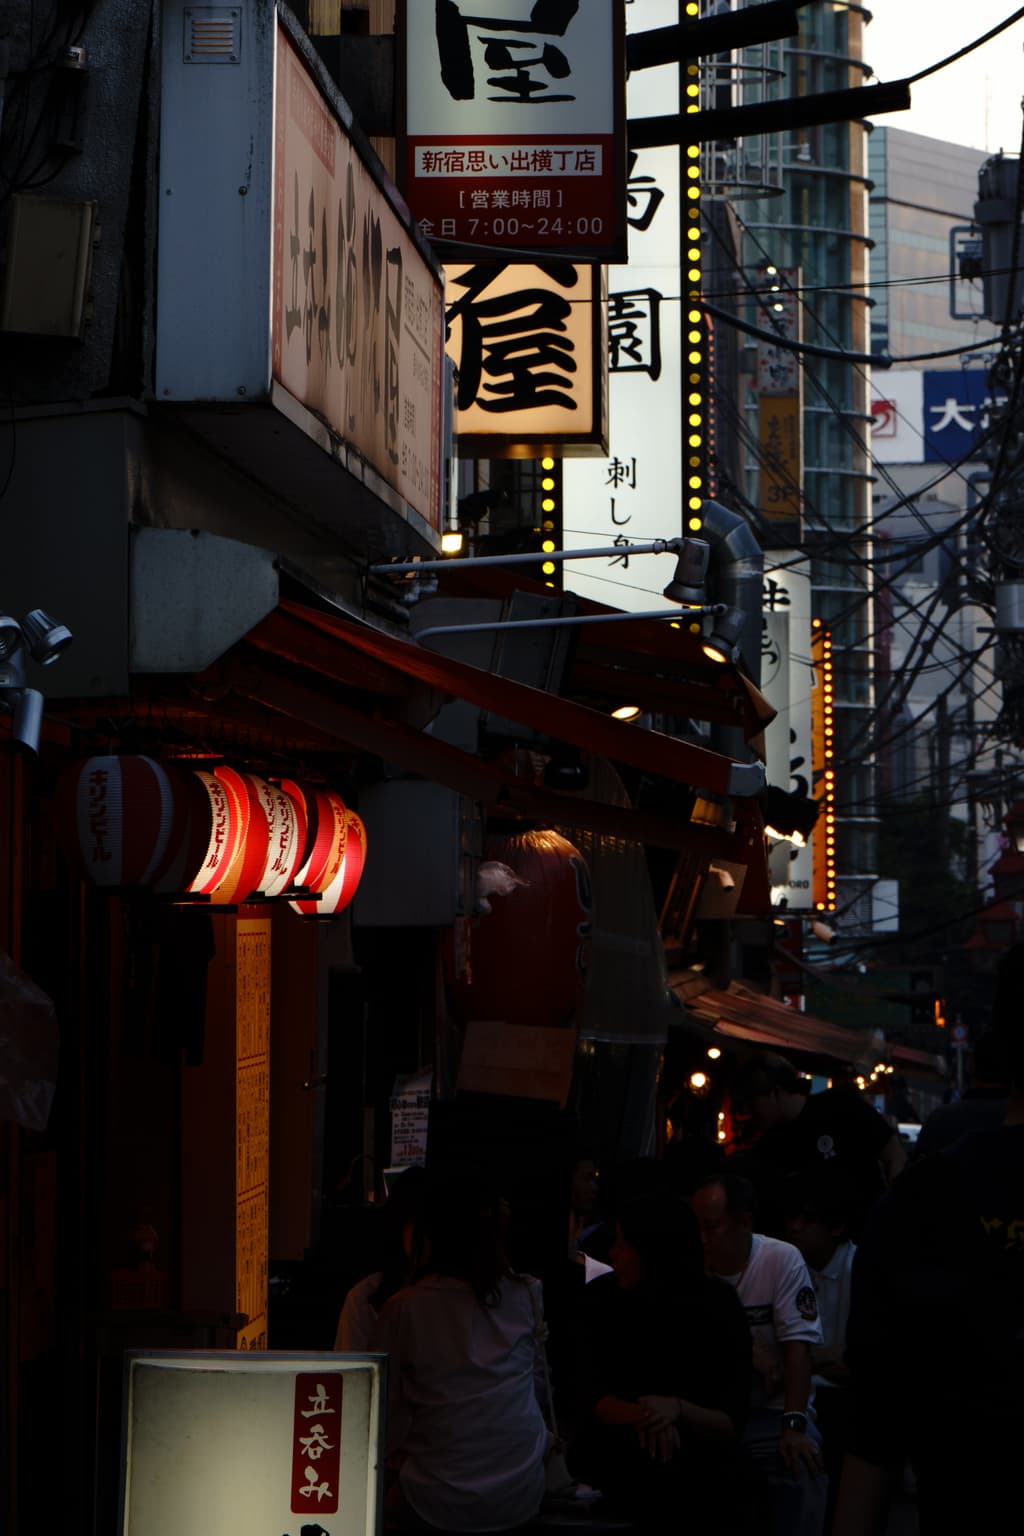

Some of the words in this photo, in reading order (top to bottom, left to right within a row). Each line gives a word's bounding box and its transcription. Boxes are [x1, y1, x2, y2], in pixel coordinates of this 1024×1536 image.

[422, 150, 596, 172] 新宿思い出横丁店
[605, 457, 637, 568] 刺し身
[298, 1384, 335, 1503] 立呑み
